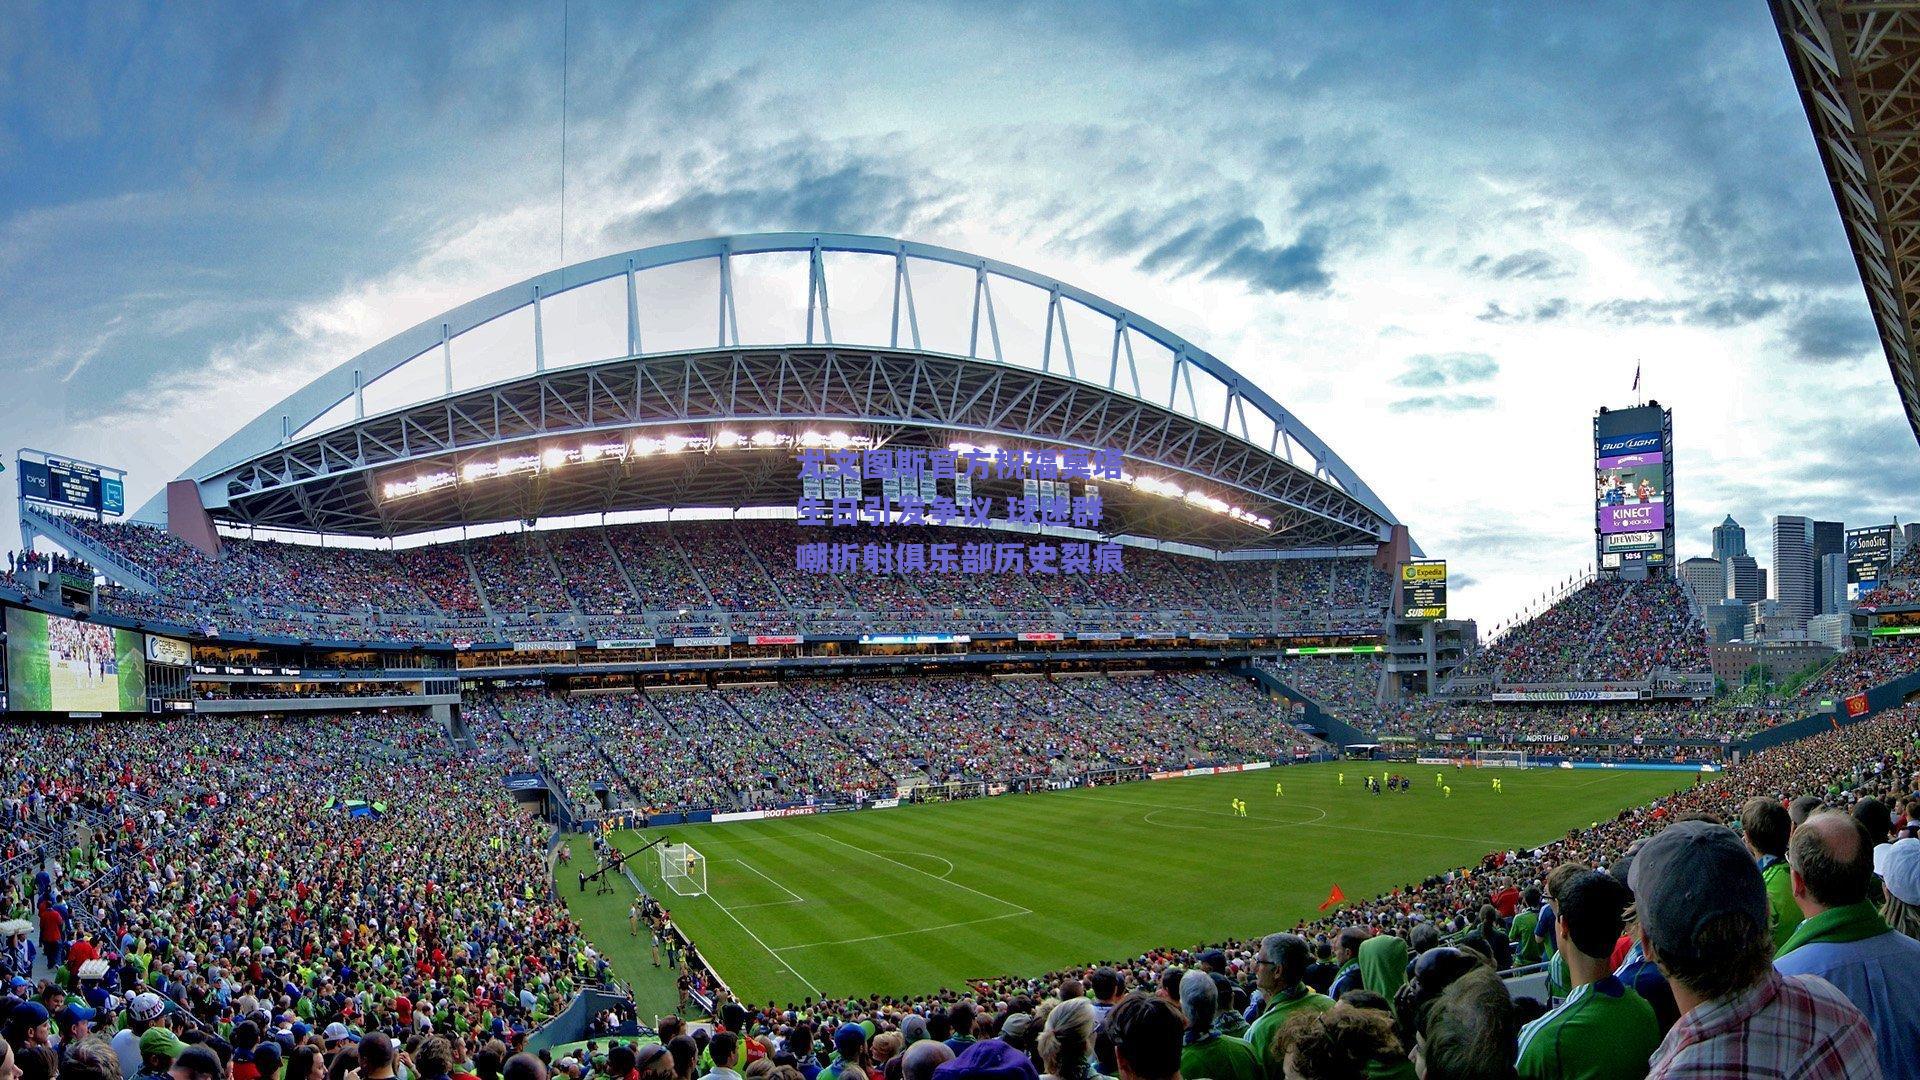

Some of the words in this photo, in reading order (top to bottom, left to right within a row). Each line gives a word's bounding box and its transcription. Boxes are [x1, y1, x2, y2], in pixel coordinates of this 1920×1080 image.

[1602, 442, 1624, 451] BUD
[1626, 437, 1658, 448] LIGHT
[26, 474, 46, 487] bing
[1613, 507, 1652, 519] KINECT
[1858, 535, 1886, 549] SonoSite
[1417, 569, 1442, 577] Expedia
[1405, 608, 1445, 618] SUBWAY
[765, 809, 786, 818] ROOT
